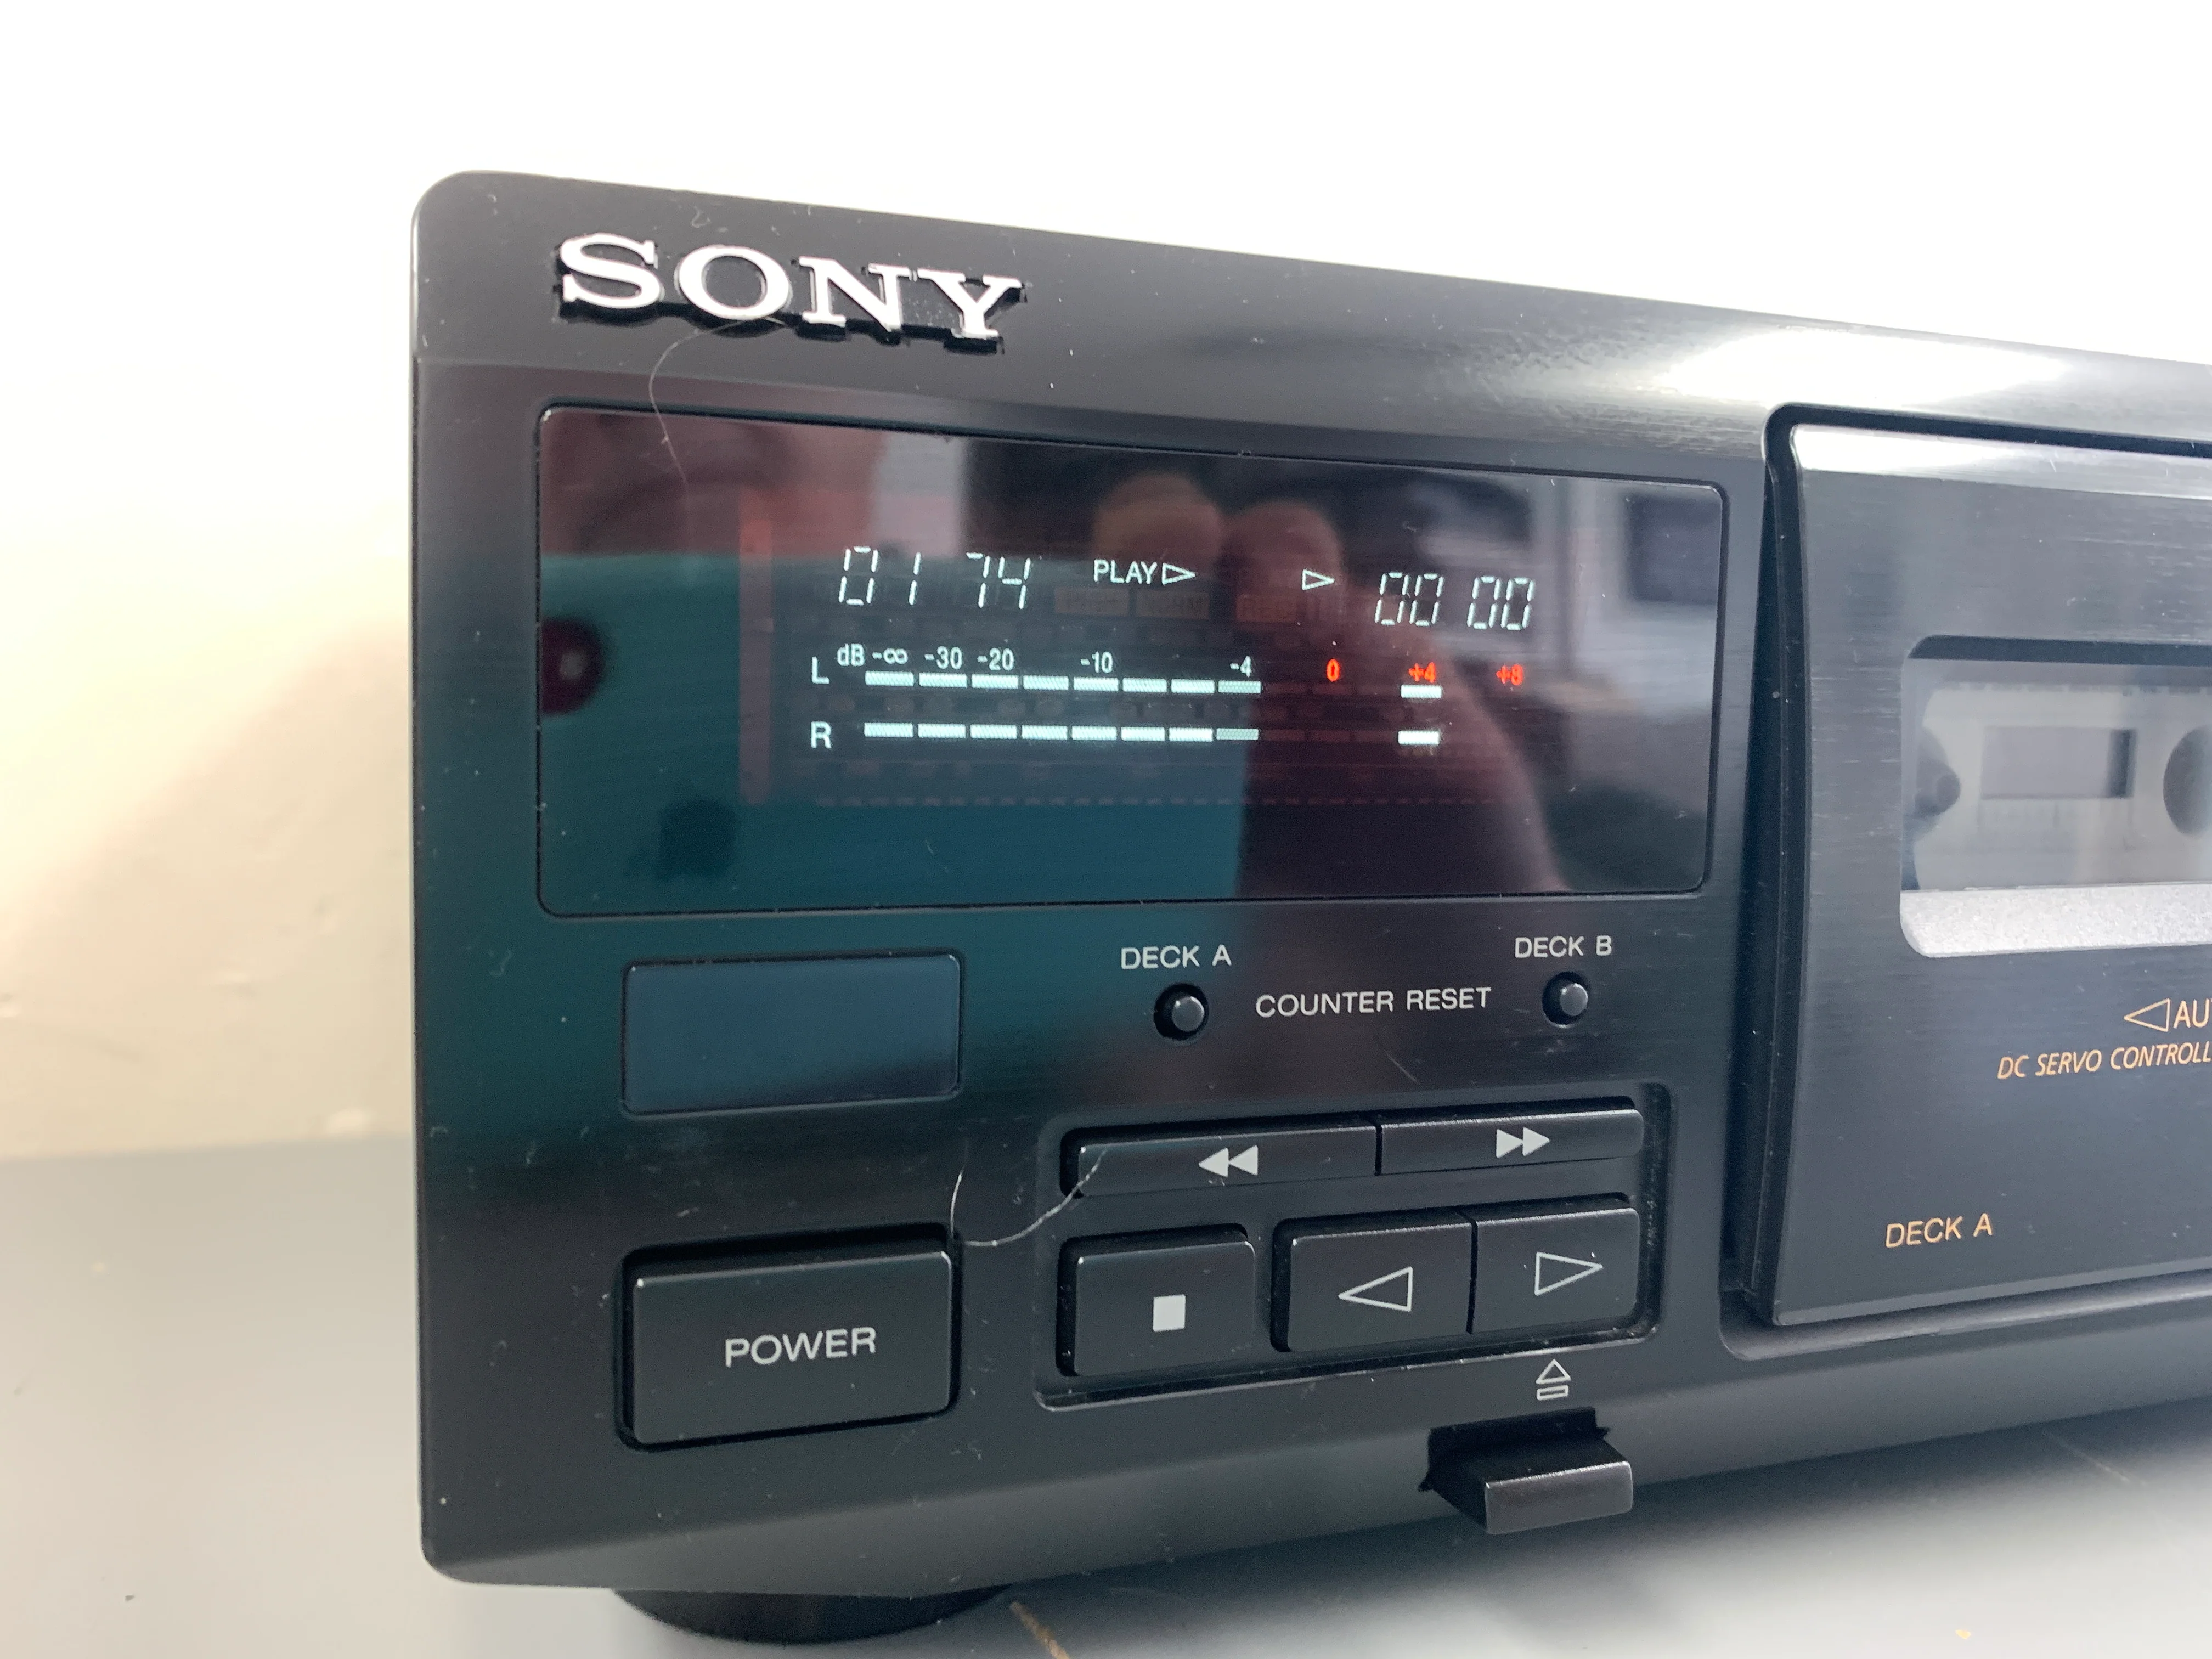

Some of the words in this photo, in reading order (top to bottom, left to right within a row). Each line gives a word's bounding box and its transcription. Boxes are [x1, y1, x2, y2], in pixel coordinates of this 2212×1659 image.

[559, 232, 1022, 340] SONY
[838, 545, 922, 606] 01
[966, 552, 1031, 610] 74
[1093, 558, 1158, 585] PLAY
[1374, 572, 1444, 627] 00
[1466, 575, 1535, 631] 00
[811, 656, 830, 685] L
[837, 643, 865, 667] dB
[924, 646, 963, 670] -30
[977, 647, 1015, 672] -20
[1080, 651, 1114, 674] -10
[1229, 656, 1252, 678] -4
[1326, 658, 1341, 682] 0
[1408, 661, 1437, 685] +4
[810, 721, 832, 749] R
[1120, 945, 1200, 970] DECK
[1211, 944, 1232, 967] A
[1514, 935, 1585, 958] DECK
[1595, 934, 1612, 956] B
[1255, 990, 1394, 1018] COUNTER
[1406, 986, 1492, 1011] RESET
[2173, 998, 2212, 1029] AU
[1997, 1054, 2029, 1080] DC
[2035, 1049, 2102, 1076] SERVO
[1885, 1216, 1963, 1248] DECK
[1973, 1212, 1993, 1237] A
[725, 1326, 877, 1368] POWER
